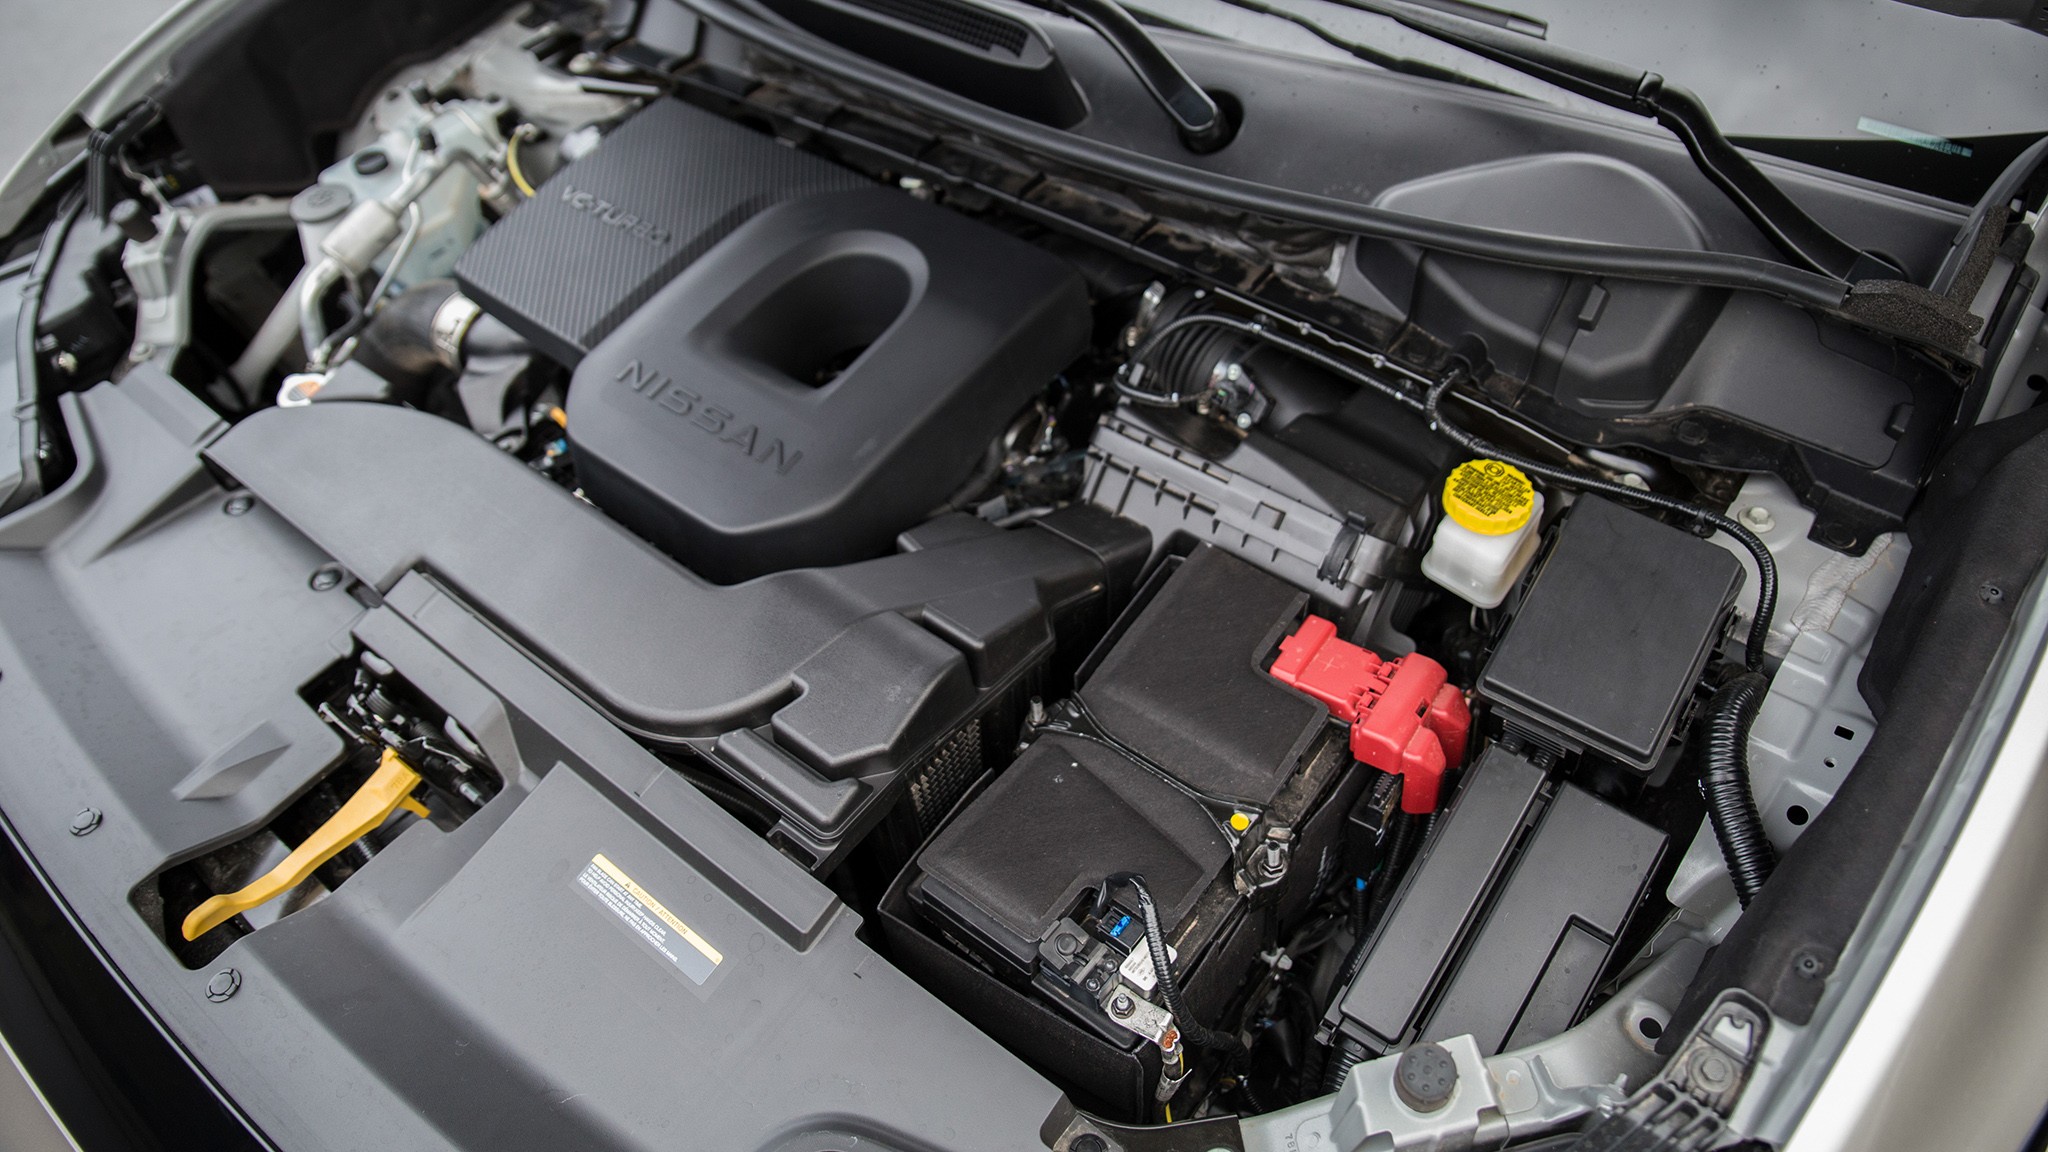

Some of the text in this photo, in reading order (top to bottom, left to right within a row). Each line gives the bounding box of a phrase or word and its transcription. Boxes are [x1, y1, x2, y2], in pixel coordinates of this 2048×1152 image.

[616, 358, 804, 475] NISSAN
[631, 886, 656, 908] CAUTION
[658, 908, 687, 935] ATTENTION
[1285, 1132, 1298, 1152] 78
